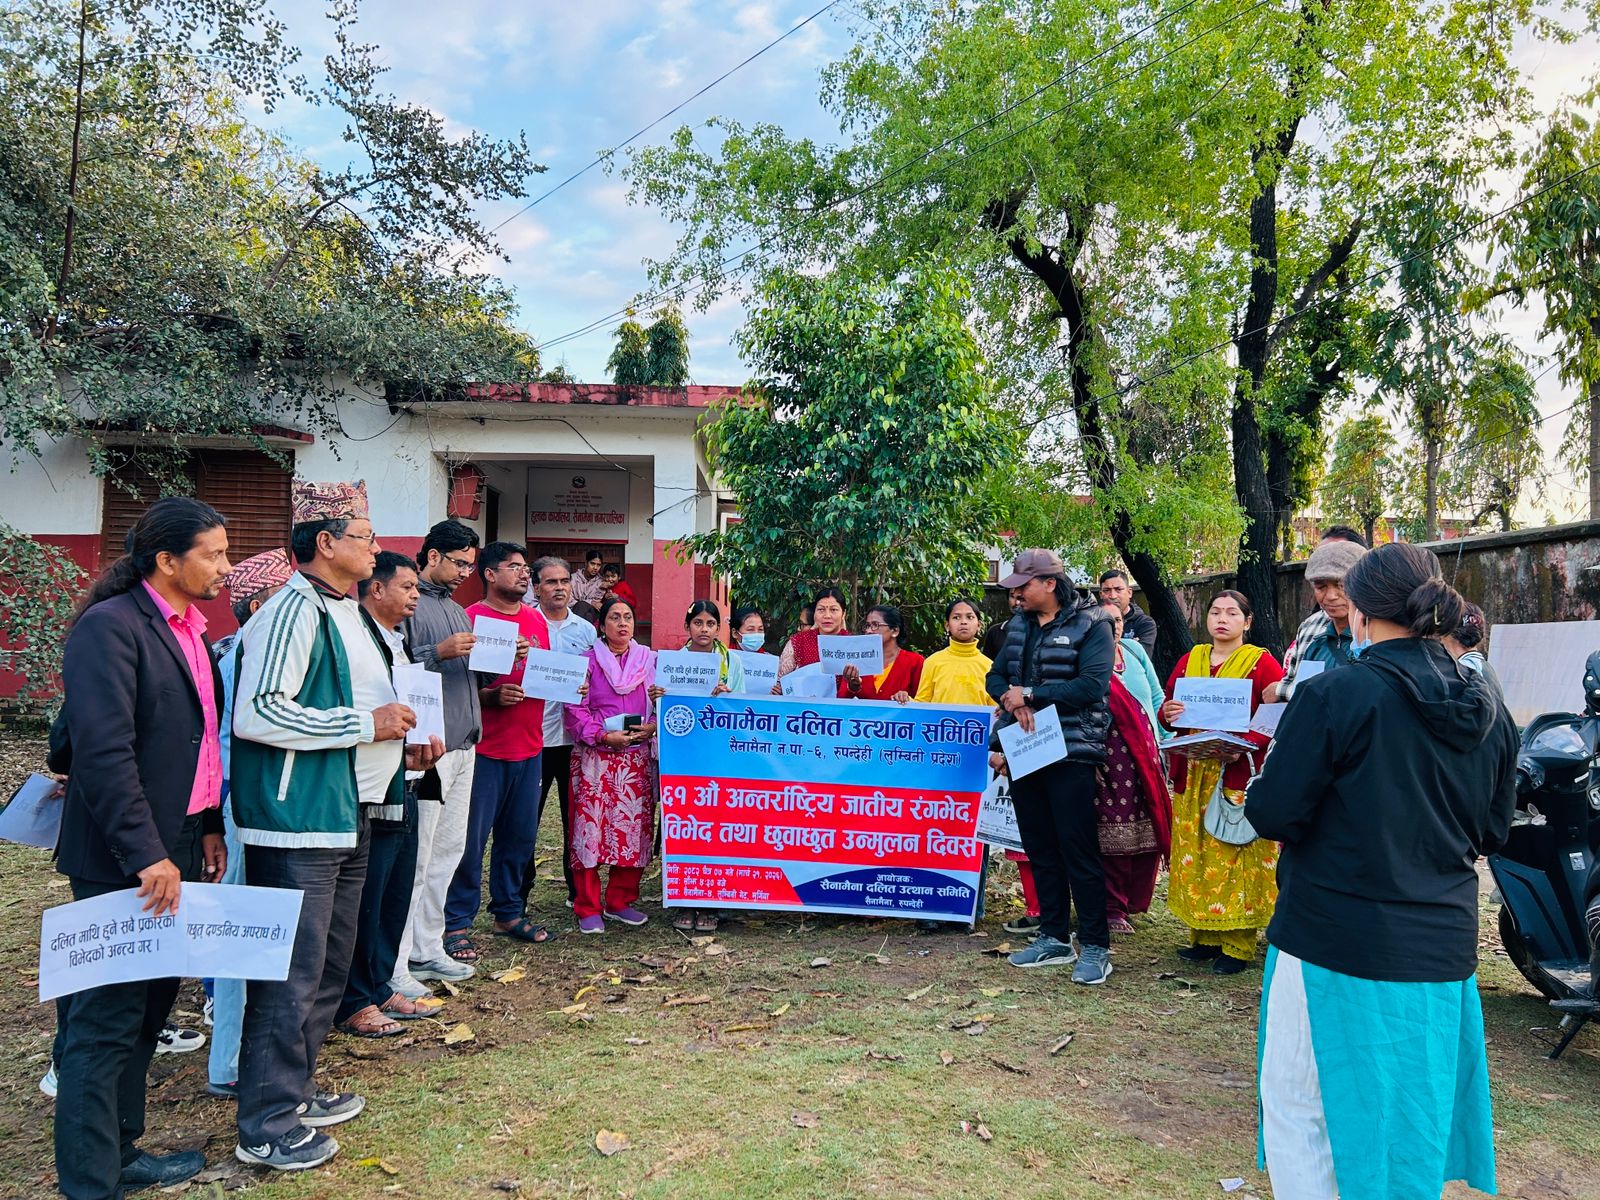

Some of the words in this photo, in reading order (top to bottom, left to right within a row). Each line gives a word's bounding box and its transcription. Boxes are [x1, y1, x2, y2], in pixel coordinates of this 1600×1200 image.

[698, 704, 780, 733] सैनामैना
[786, 709, 843, 736] दलित
[849, 717, 916, 741] उत्थान
[921, 717, 988, 746] समिति
[729, 736, 773, 753] सैनामैना
[834, 744, 873, 761] रुपन्देही
[880, 745, 925, 766] (लुम्बिनी
[931, 749, 961, 767] प्रदेश)
[663, 785, 687, 808] ६१
[840, 791, 905, 818] जातीय
[910, 795, 974, 823] रंगभेद,
[664, 813, 714, 843] विभेद
[719, 822, 758, 844] तथा
[763, 825, 837, 854] छुवाछुत
[842, 829, 921, 858] उन्मुलन
[926, 828, 977, 858] दिवस
[820, 878, 863, 892] सैनामैना
[866, 882, 897, 894] दलित
[899, 884, 934, 896] उत्थान
[936, 886, 971, 899] समिति
[50, 933, 76, 951] दलित
[78, 924, 100, 943] माथि
[102, 919, 117, 940] हुने
[121, 914, 135, 934] सबै
[205, 920, 240, 937] दण्डनिय
[270, 923, 281, 940] हो
[69, 944, 105, 968] विभेदको
[107, 941, 135, 958] अन्त्य
[137, 939, 152, 953] गर
